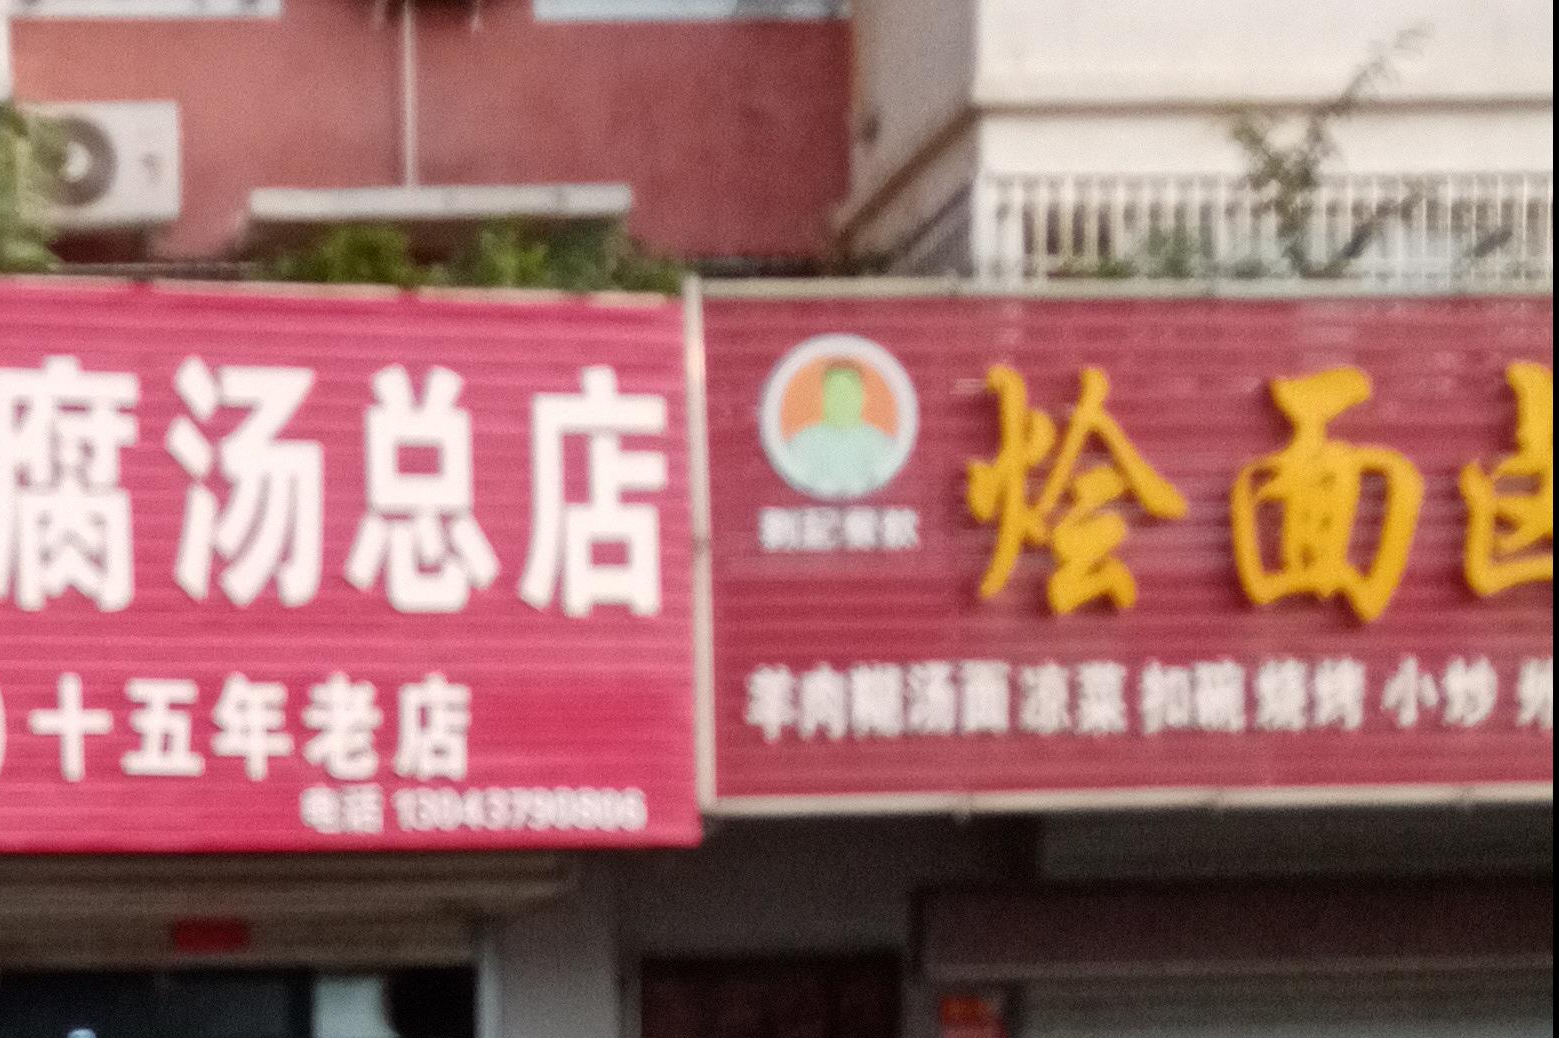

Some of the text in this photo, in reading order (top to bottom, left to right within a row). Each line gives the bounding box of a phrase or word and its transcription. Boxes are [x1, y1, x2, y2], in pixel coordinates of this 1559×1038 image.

[1017, 659, 1129, 737] 凉菜
[1140, 656, 1245, 736] 扣碗
[1255, 654, 1366, 733] 烧烤
[1380, 652, 1499, 729] 小炒
[298, 786, 385, 835] 电话
